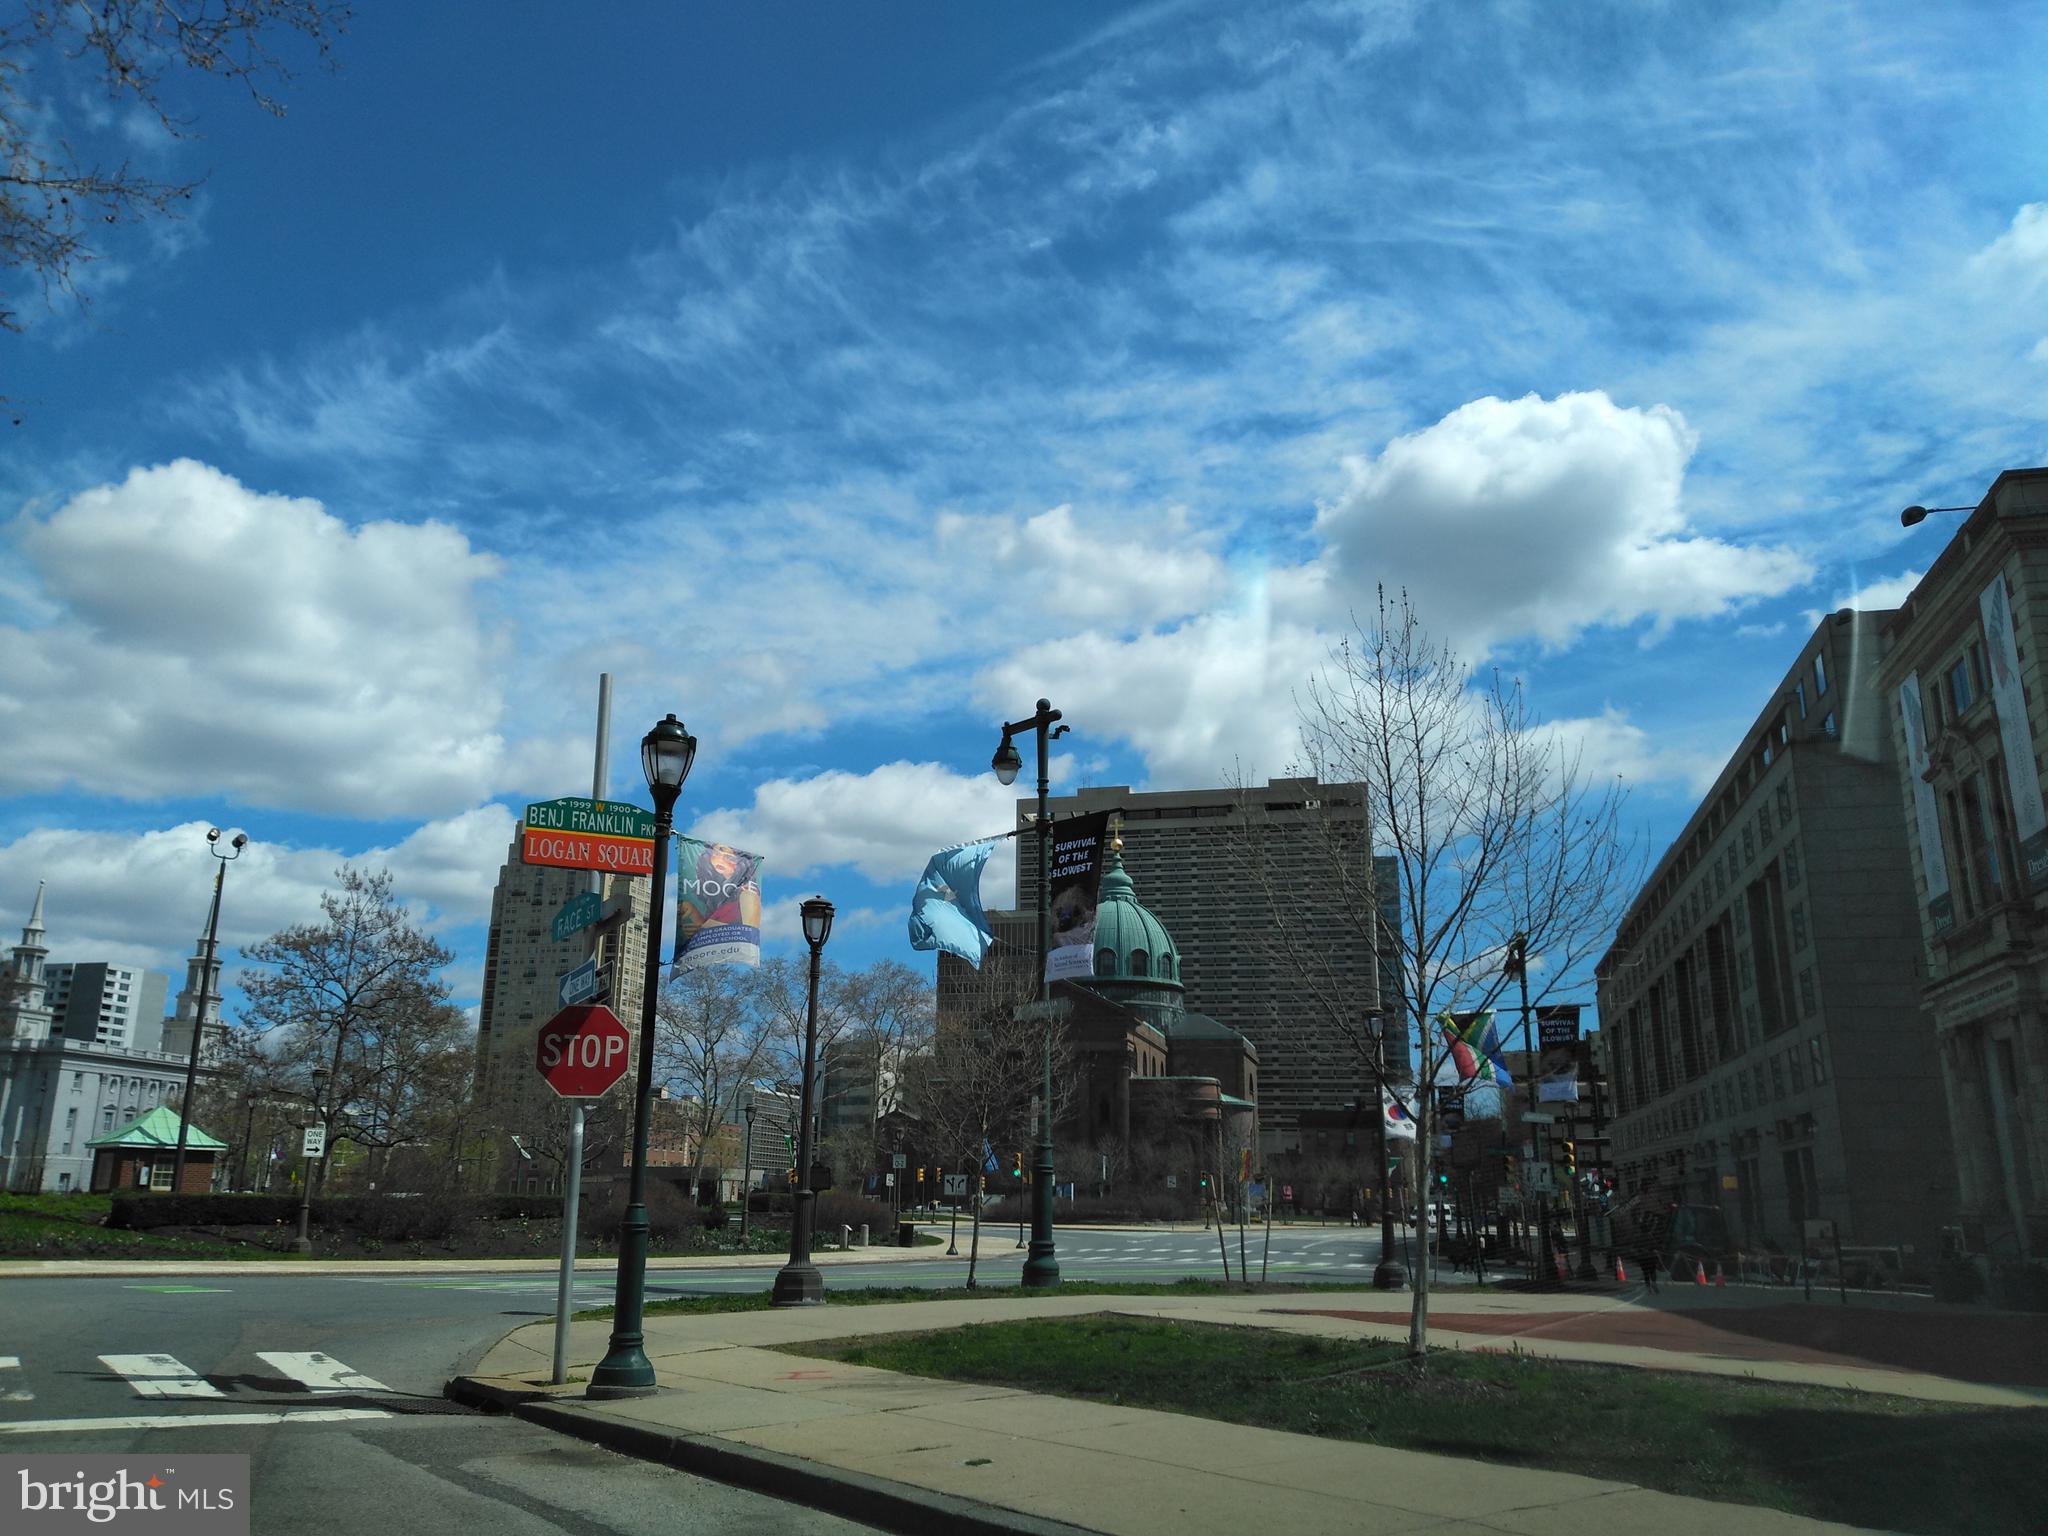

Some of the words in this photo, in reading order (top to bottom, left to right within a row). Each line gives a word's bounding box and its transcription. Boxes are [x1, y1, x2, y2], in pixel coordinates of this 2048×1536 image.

[570, 800, 591, 809] 1999
[609, 804, 631, 813] 1900
[529, 806, 564, 828] BENJ
[571, 810, 634, 834] FRANKLIN
[1055, 836, 1096, 852] SURVIVAL
[528, 837, 591, 862] LOGAN
[597, 843, 653, 869] SQUAR
[1058, 853, 1070, 864] OF
[1072, 850, 1089, 862] THE
[1052, 862, 1093, 878] SLOWEST
[558, 908, 582, 937] RACE
[586, 904, 595, 920] ST
[684, 946, 740, 963] moore.edu
[542, 1033, 624, 1068] STOP
[307, 1130, 323, 1138] ONE
